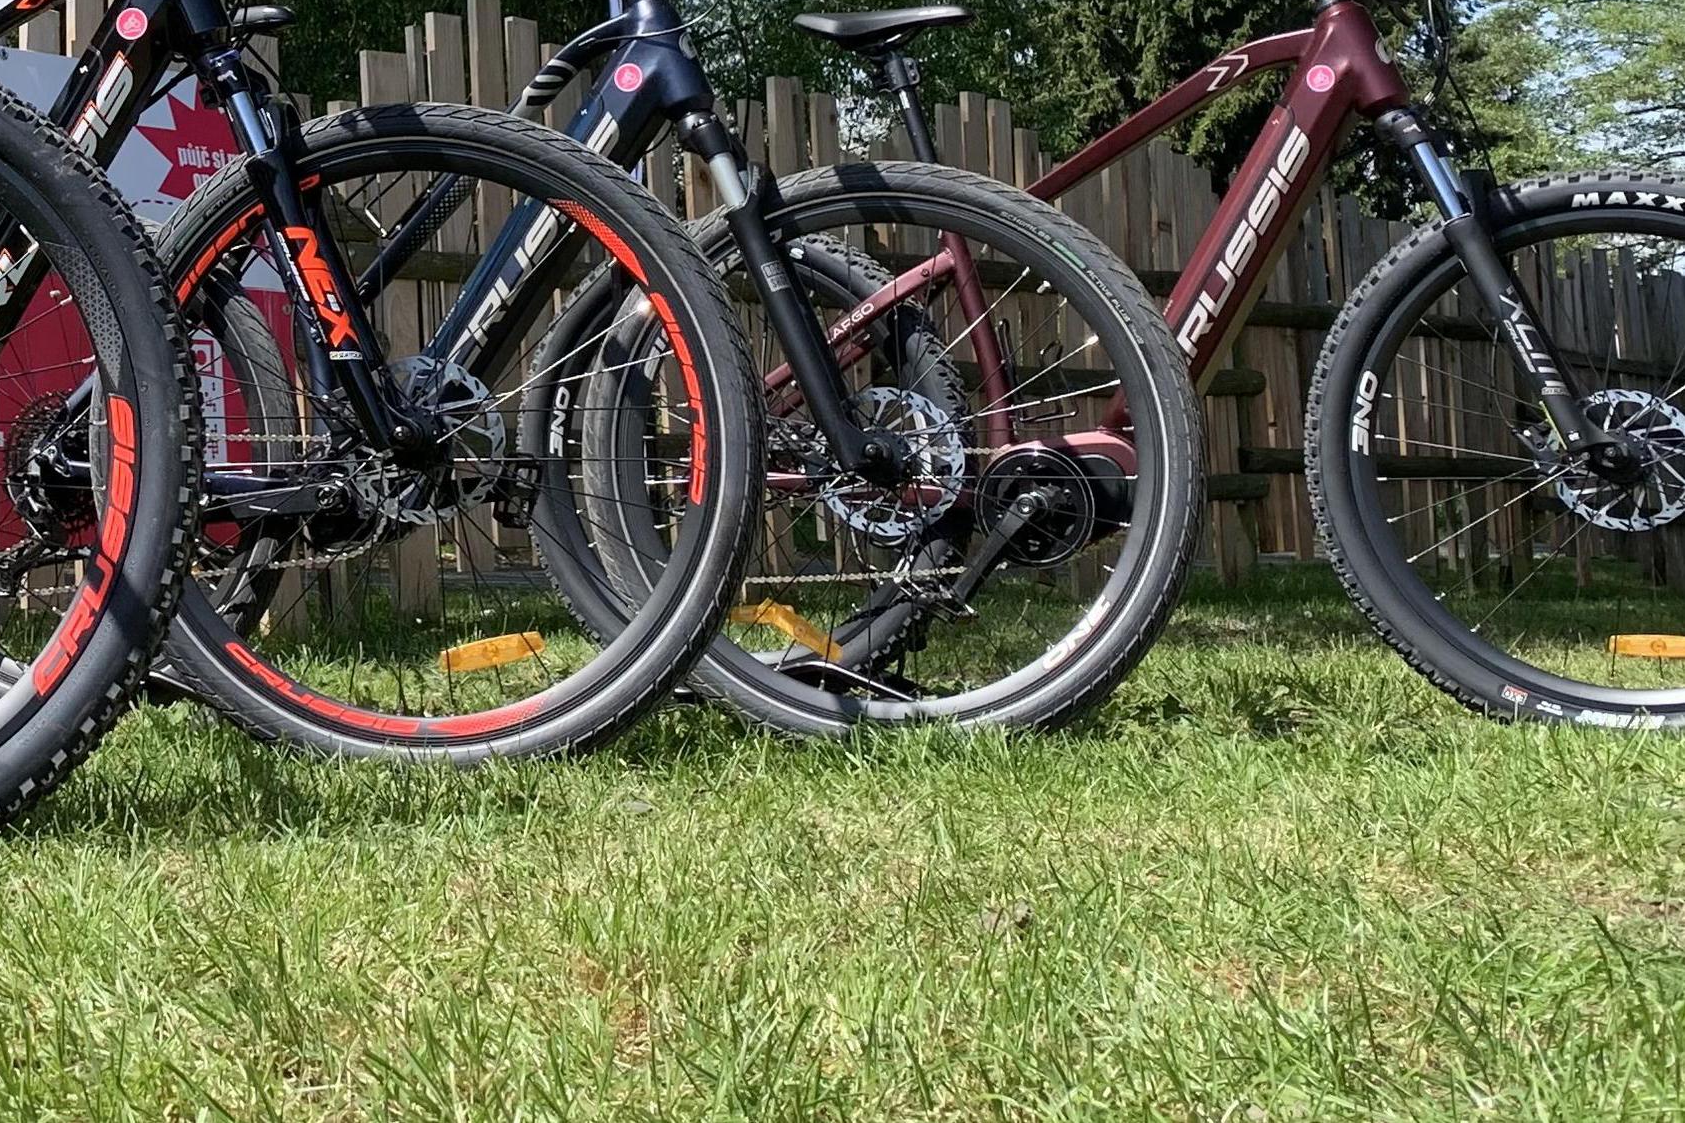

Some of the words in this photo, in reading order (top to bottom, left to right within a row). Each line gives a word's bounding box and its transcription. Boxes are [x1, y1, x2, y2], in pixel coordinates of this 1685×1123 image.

[285, 227, 360, 347] NEX
[1177, 126, 1310, 363] RUSSIS
[827, 302, 875, 344] ARGO
[549, 385, 571, 457] ONE
[1351, 370, 1379, 456] ONE
[33, 394, 136, 697] CRUSSIS
